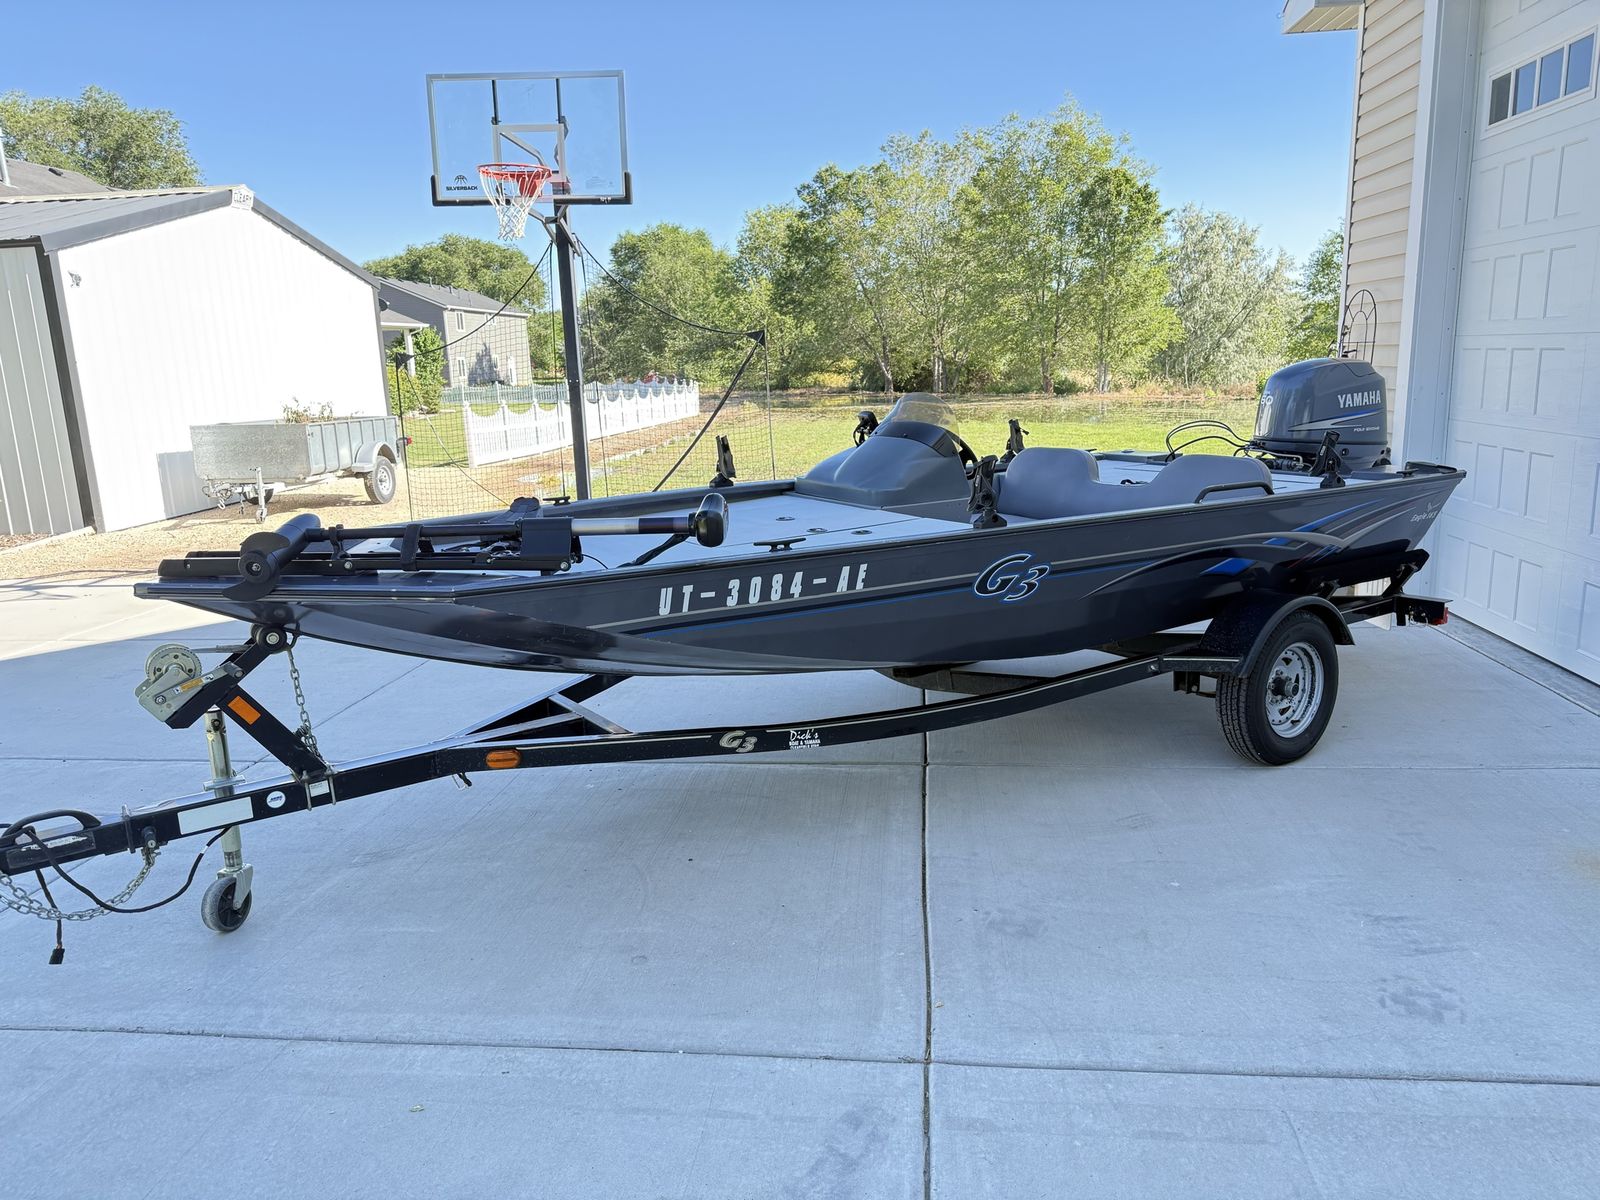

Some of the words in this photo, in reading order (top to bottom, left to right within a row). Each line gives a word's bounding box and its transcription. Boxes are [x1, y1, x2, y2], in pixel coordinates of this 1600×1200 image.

[1337, 390, 1382, 409] YAMAHA
[973, 552, 1050, 602] G3
[719, 730, 758, 753] G3
[789, 728, 819, 741] Dick's
